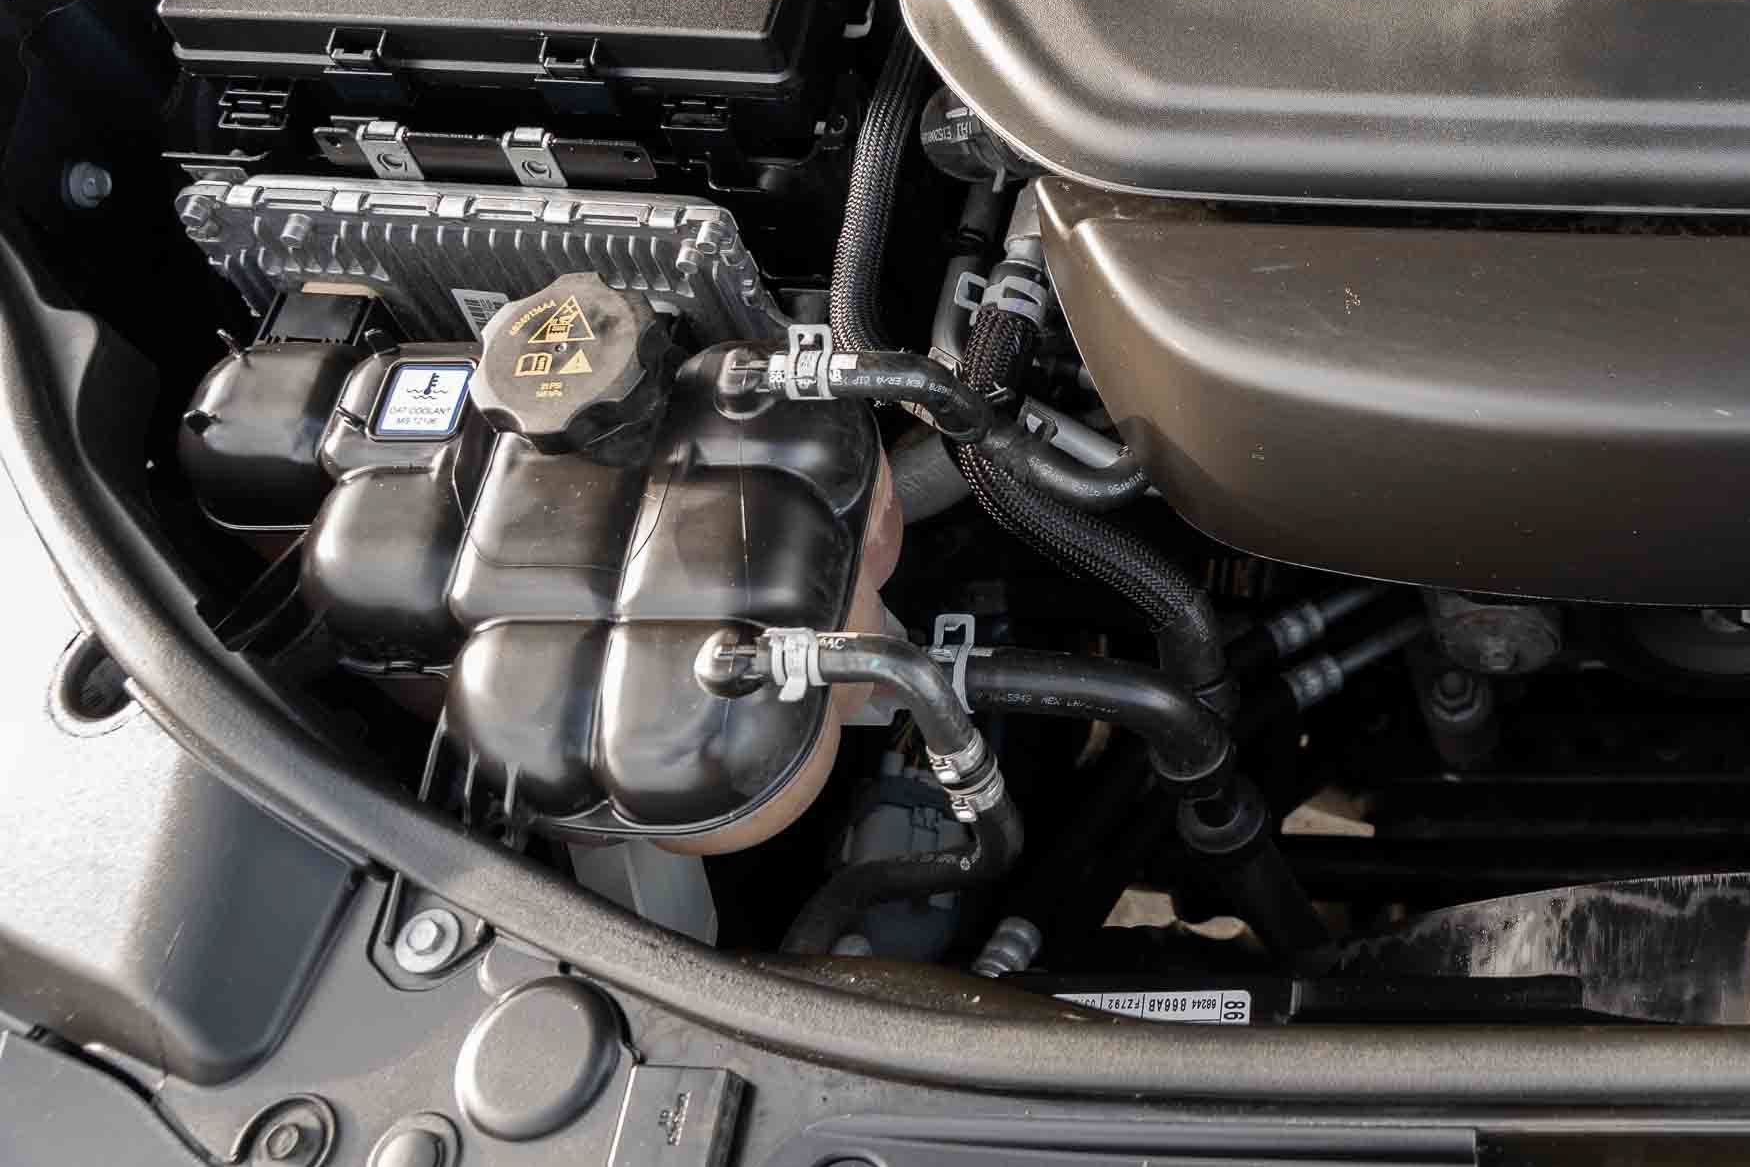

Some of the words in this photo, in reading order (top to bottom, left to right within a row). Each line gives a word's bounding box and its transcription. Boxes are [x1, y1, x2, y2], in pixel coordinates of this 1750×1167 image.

[408, 405, 452, 415] COOLANT
[1107, 998, 1140, 1010] FZ792
[1149, 998, 1187, 1012] 866AB
[1191, 998, 1217, 1010] 68244
[1223, 1000, 1246, 1021] 86
